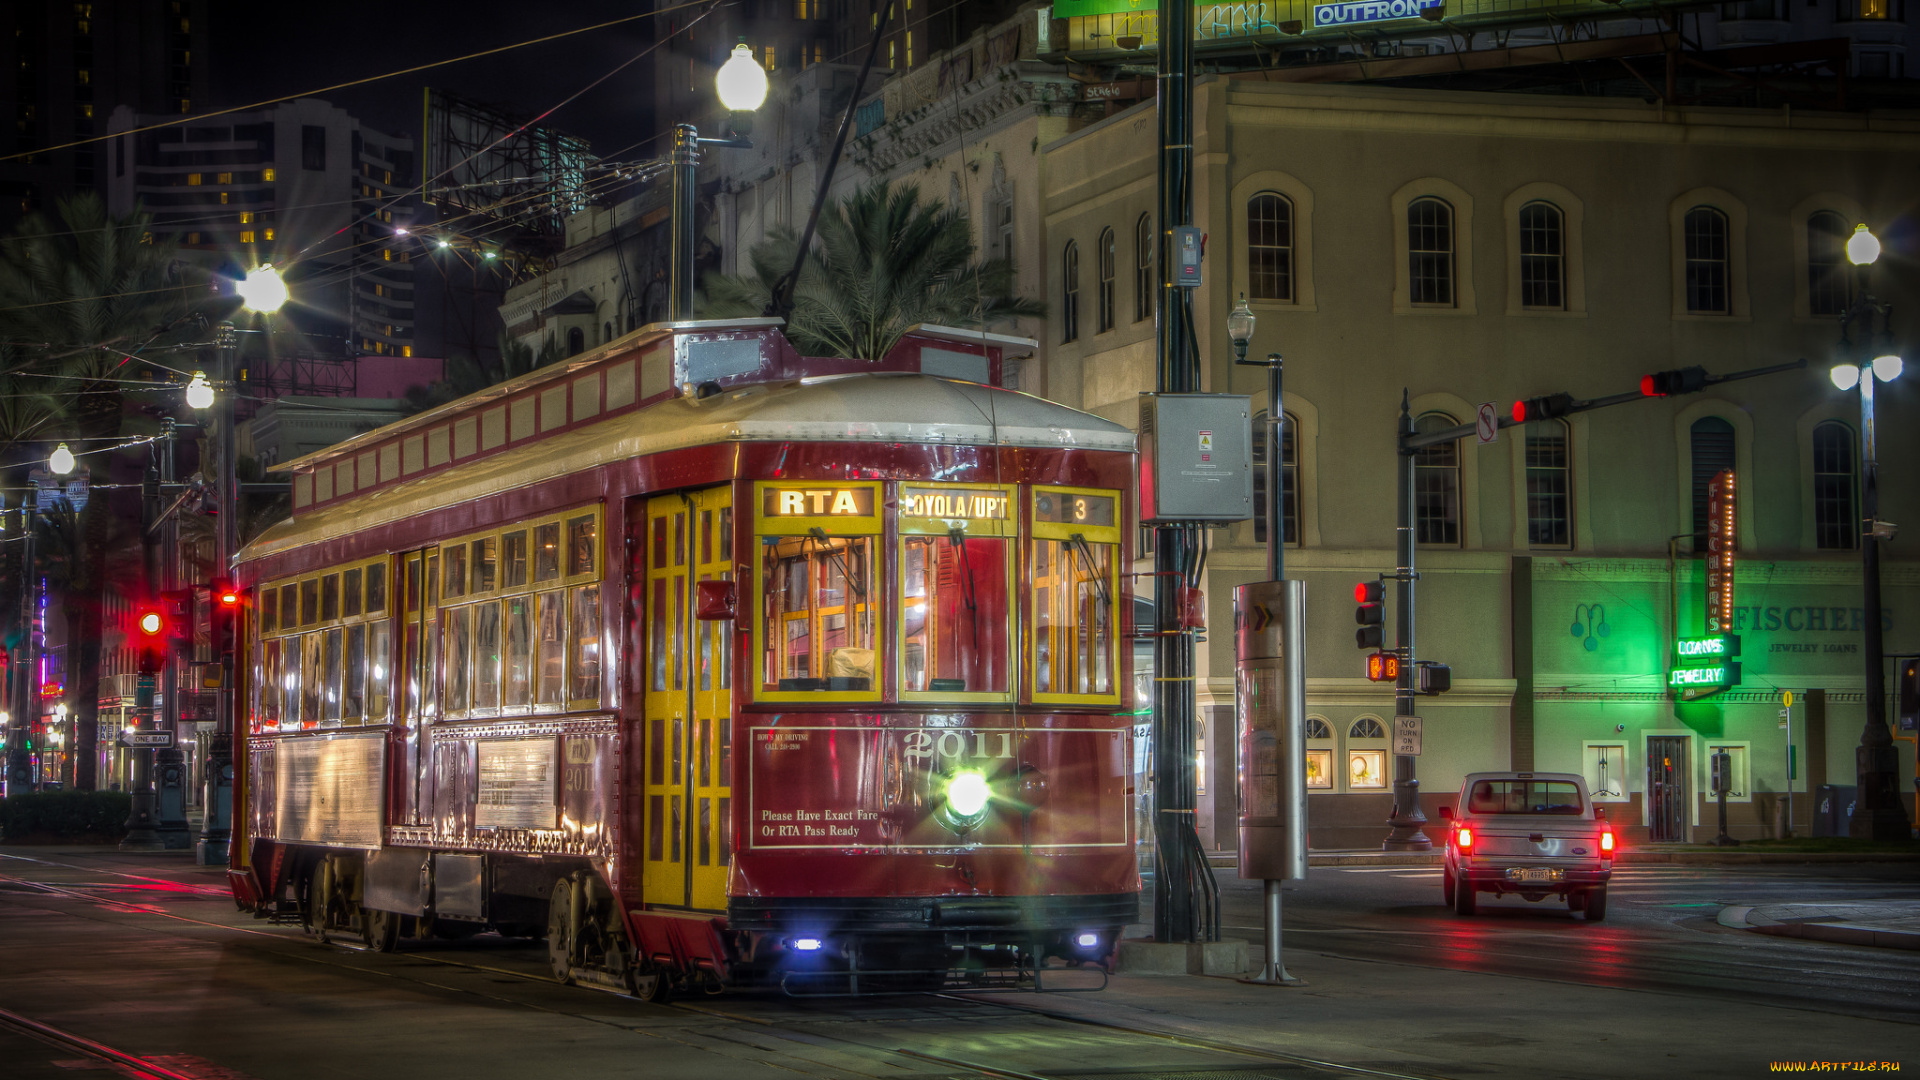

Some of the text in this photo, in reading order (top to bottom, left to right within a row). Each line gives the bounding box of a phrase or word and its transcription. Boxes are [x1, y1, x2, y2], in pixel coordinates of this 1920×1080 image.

[780, 490, 858, 514] RTA
[905, 494, 1008, 518] LOYOLA/UPT
[1074, 498, 1087, 520] 3
[1678, 638, 1724, 655] LOANS
[1769, 644, 1858, 653] JEWELRY LOANS
[1669, 668, 1724, 685] JEWELRY
[1401, 720, 1416, 729] NO
[135, 735, 167, 743] ONE WAY
[775, 733, 783, 741] MY
[785, 733, 808, 741] DRIVING
[903, 731, 1015, 759] 2011
[565, 767, 595, 792] 2011
[762, 810, 878, 821] Please Have Exact Fare
[762, 826, 859, 838] Or RTA Pass Ready
